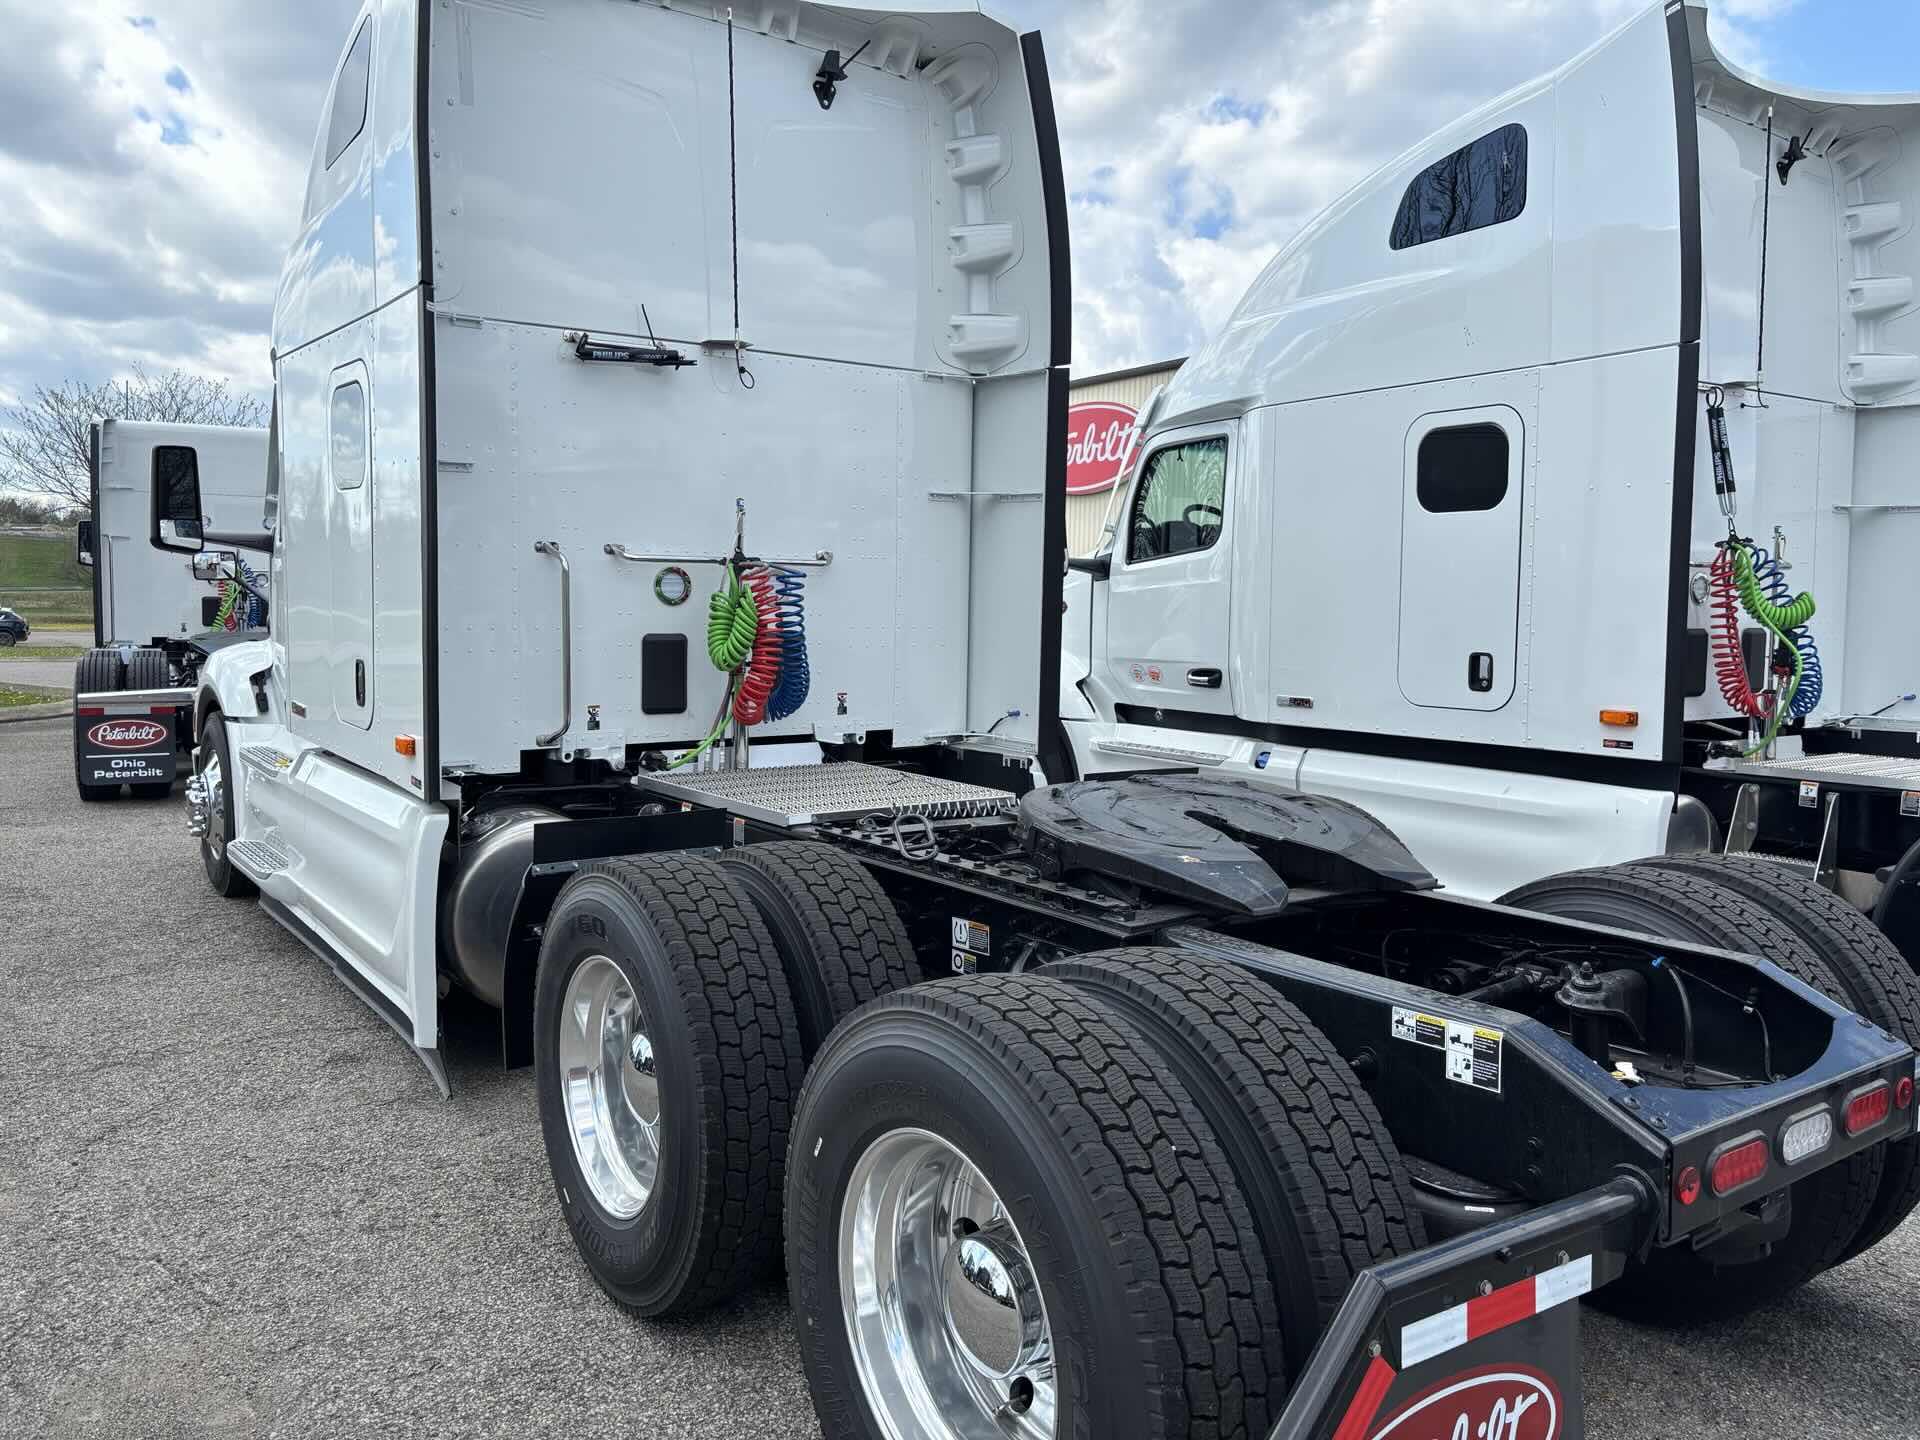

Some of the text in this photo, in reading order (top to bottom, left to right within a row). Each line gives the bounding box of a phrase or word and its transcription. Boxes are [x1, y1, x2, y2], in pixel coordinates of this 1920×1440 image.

[98, 725, 161, 741] Peterbilt
[111, 760, 145, 768] Ohio
[94, 769, 163, 779] Peterbilt
